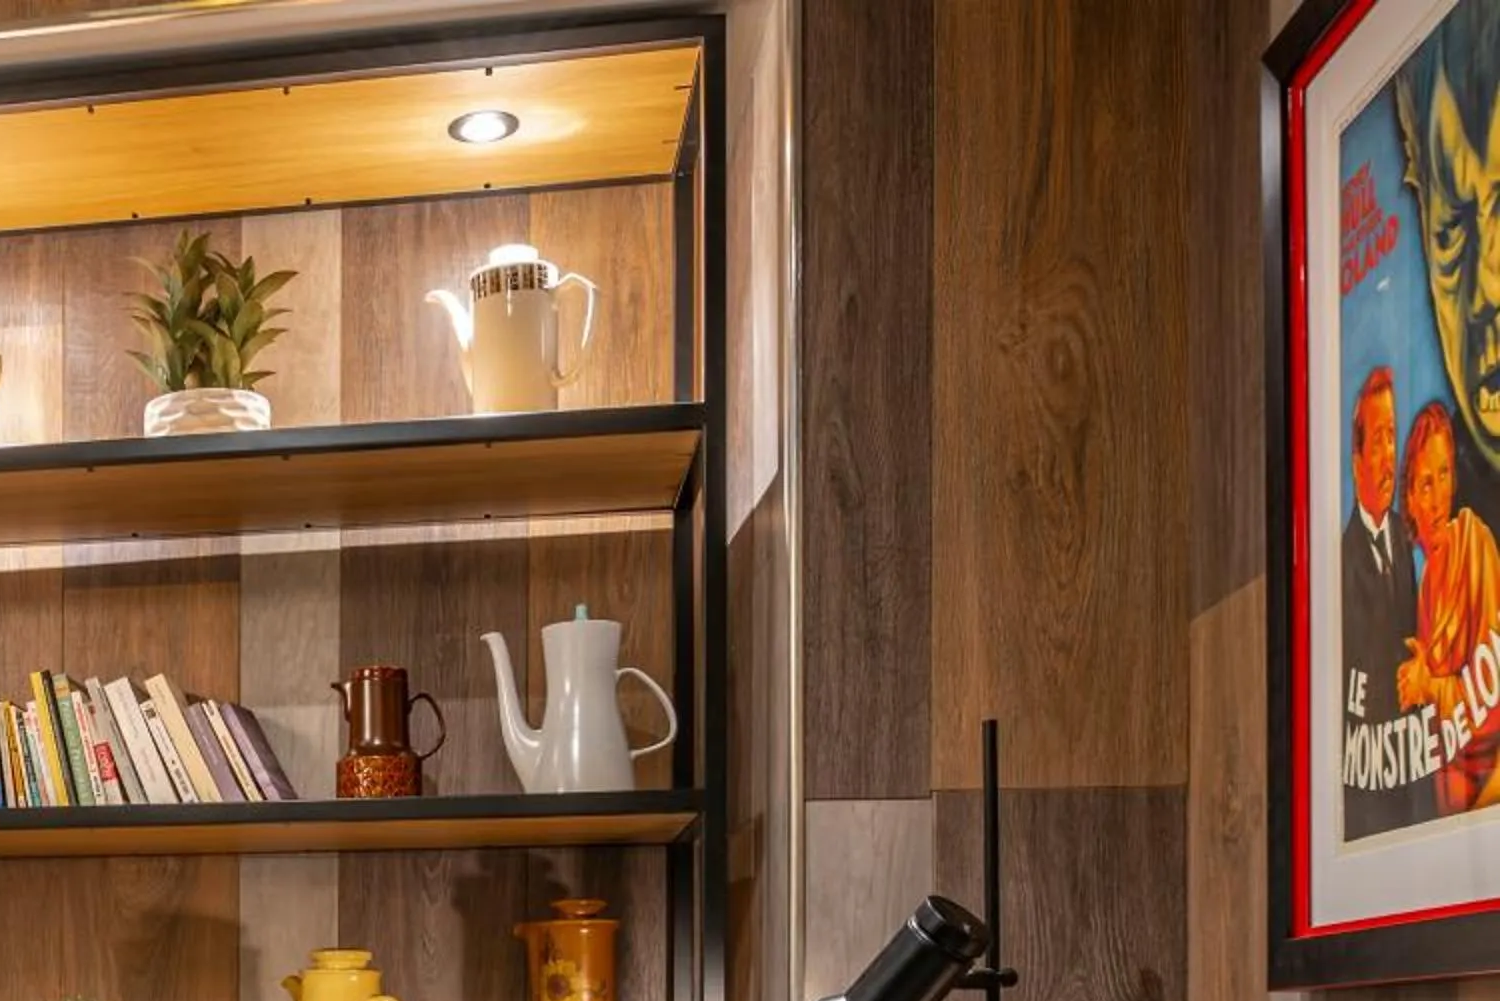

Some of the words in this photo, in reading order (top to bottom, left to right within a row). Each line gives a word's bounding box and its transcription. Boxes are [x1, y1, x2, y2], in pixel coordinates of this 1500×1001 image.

[1347, 668, 1368, 717] LE
[1343, 704, 1441, 791] MONSTRE
[1441, 701, 1472, 763] DE
